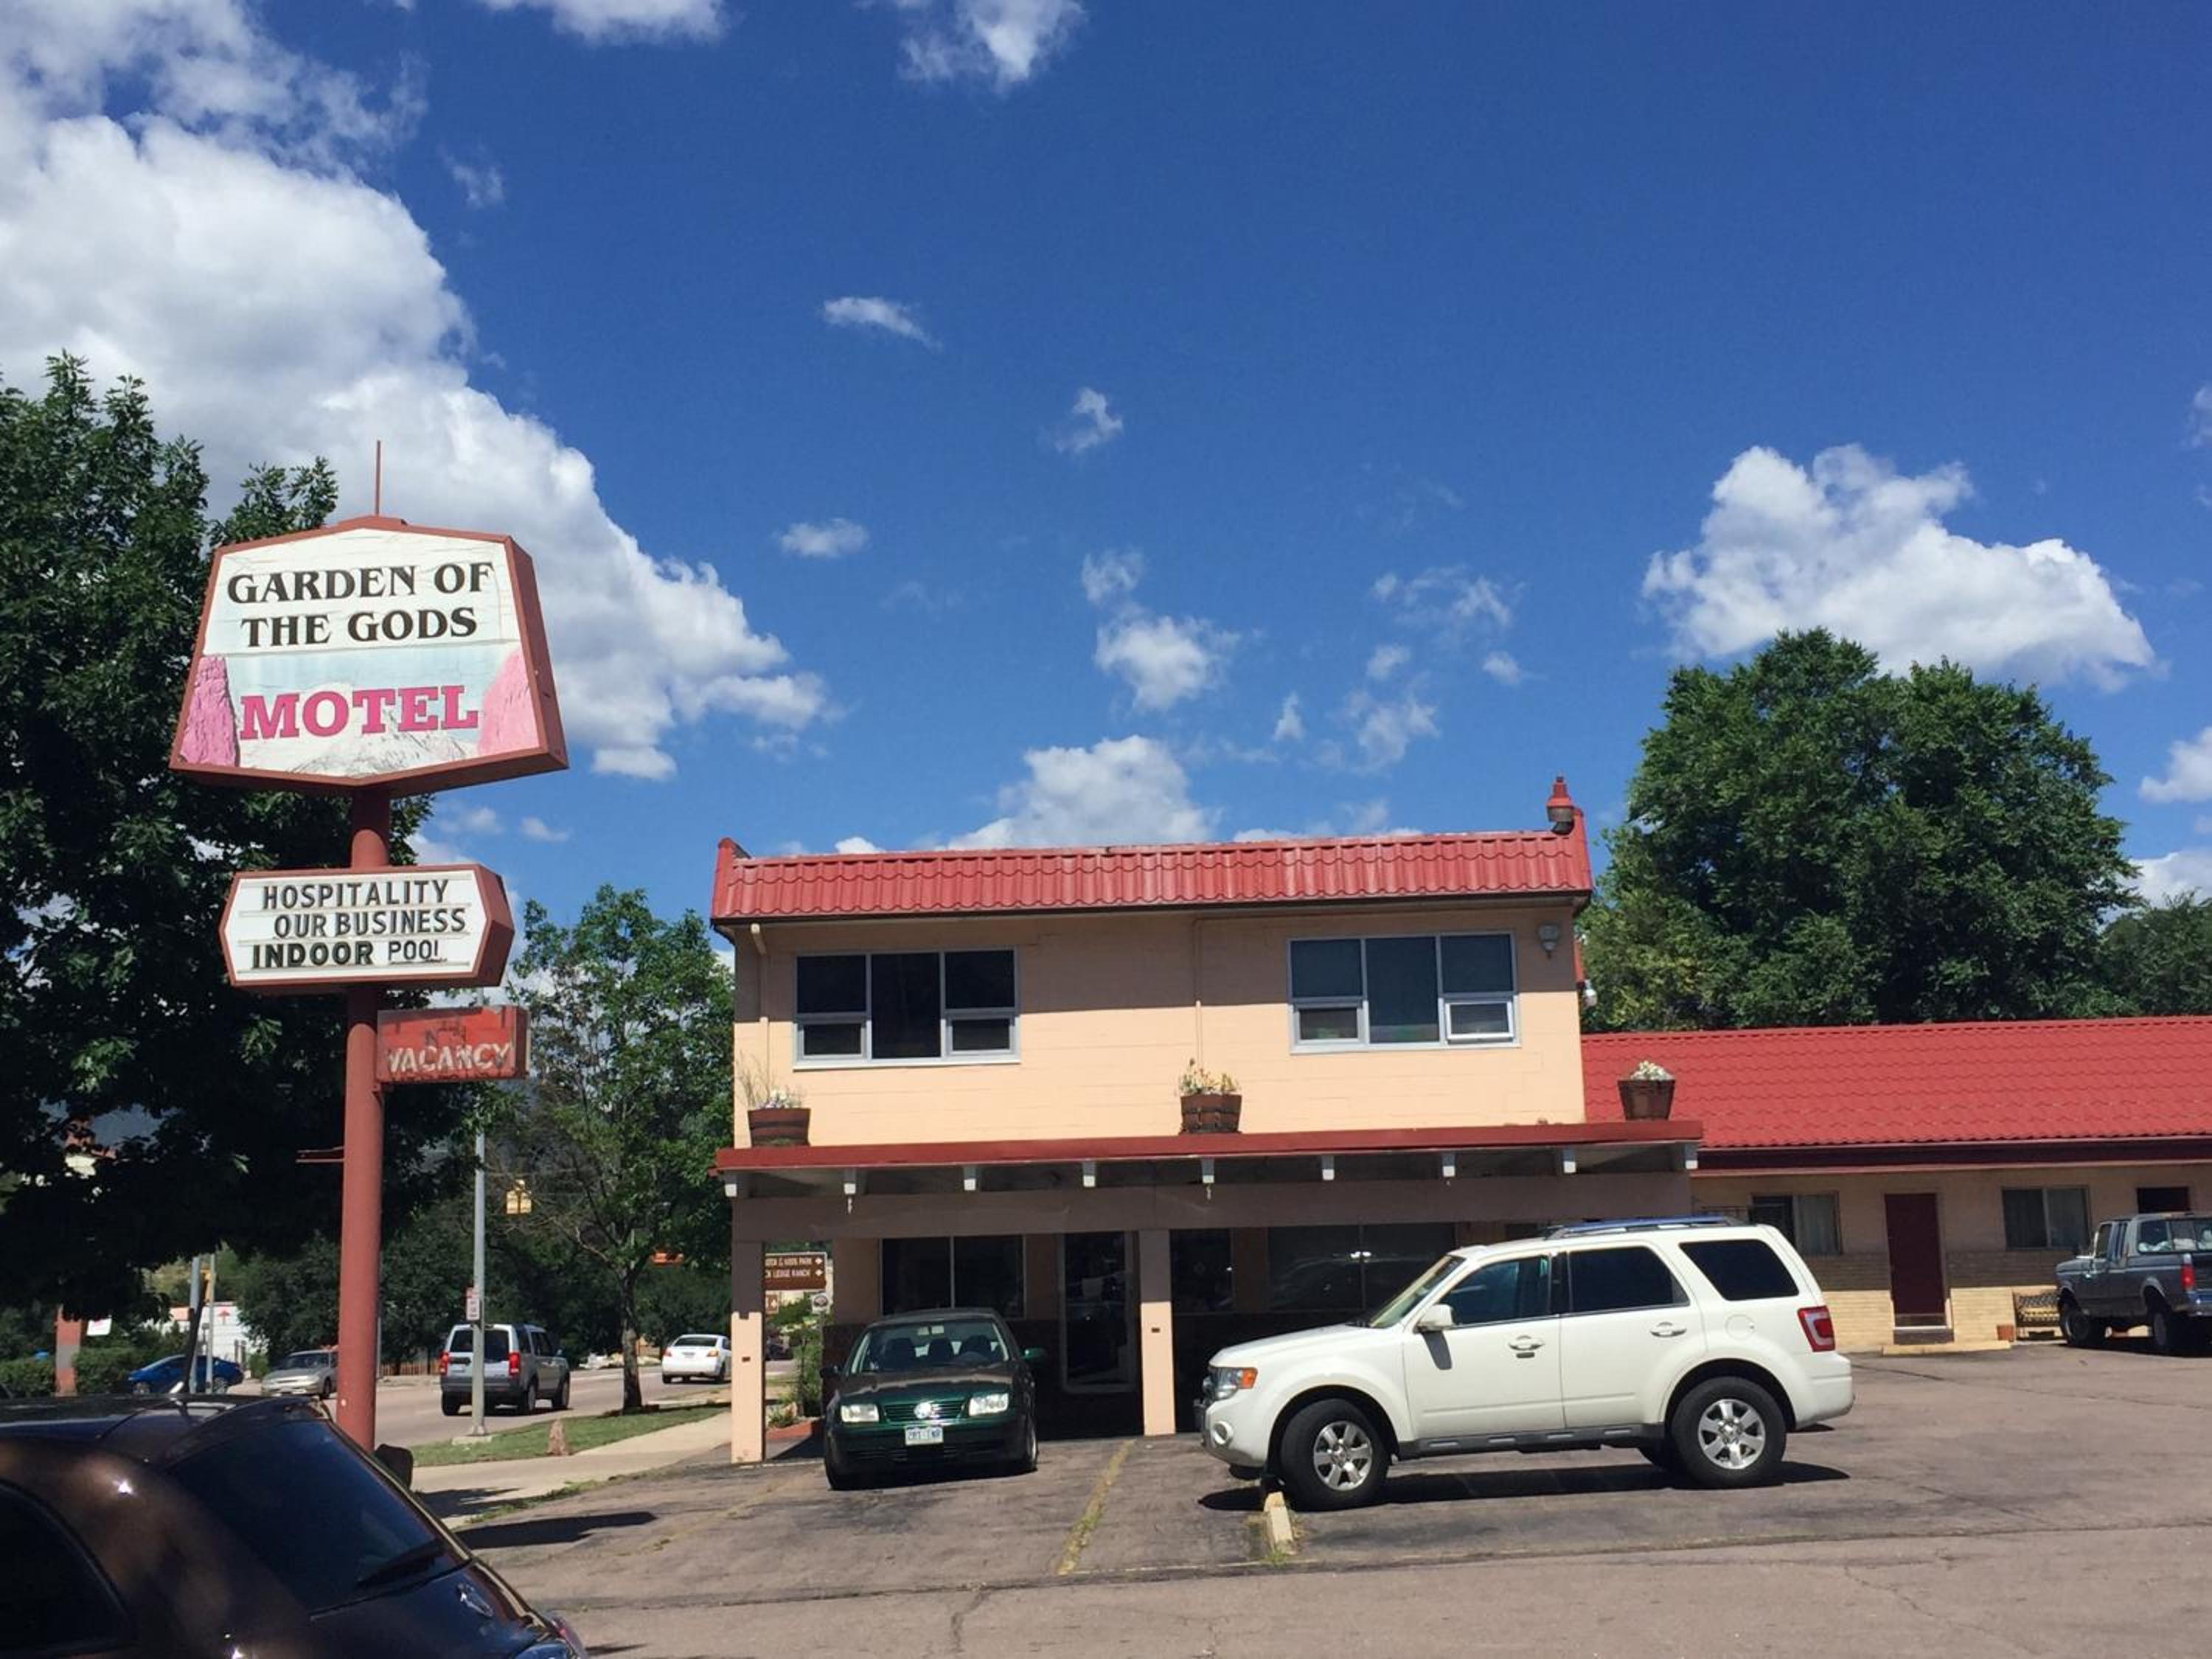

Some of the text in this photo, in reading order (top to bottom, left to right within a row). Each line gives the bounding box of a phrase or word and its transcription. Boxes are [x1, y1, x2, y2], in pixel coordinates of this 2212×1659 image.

[228, 562, 494, 605] GARDEN OF
[241, 608, 478, 647] THE GODS
[239, 685, 479, 741] MOTEL
[262, 879, 449, 910] HOSPITALITY
[274, 908, 466, 938] OUR BUSINESS
[252, 939, 447, 969] INDOOR POOL
[388, 1041, 513, 1073] VACANCY
